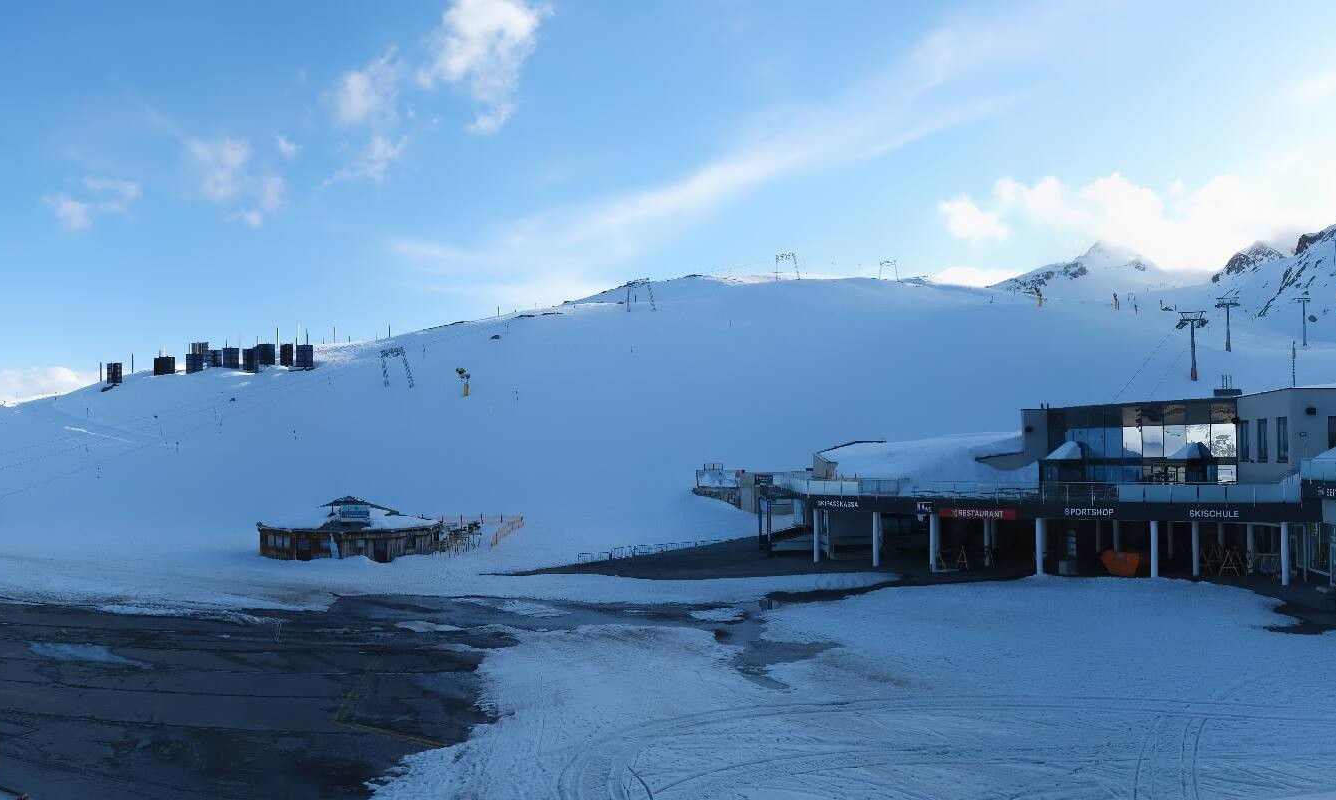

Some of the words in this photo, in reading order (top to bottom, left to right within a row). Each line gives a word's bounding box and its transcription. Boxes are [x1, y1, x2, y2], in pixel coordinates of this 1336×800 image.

[958, 509, 1004, 519] RESTAURANT
[1064, 507, 1114, 517] SPORTSHOP
[1189, 509, 1239, 519] SKISCHULE
